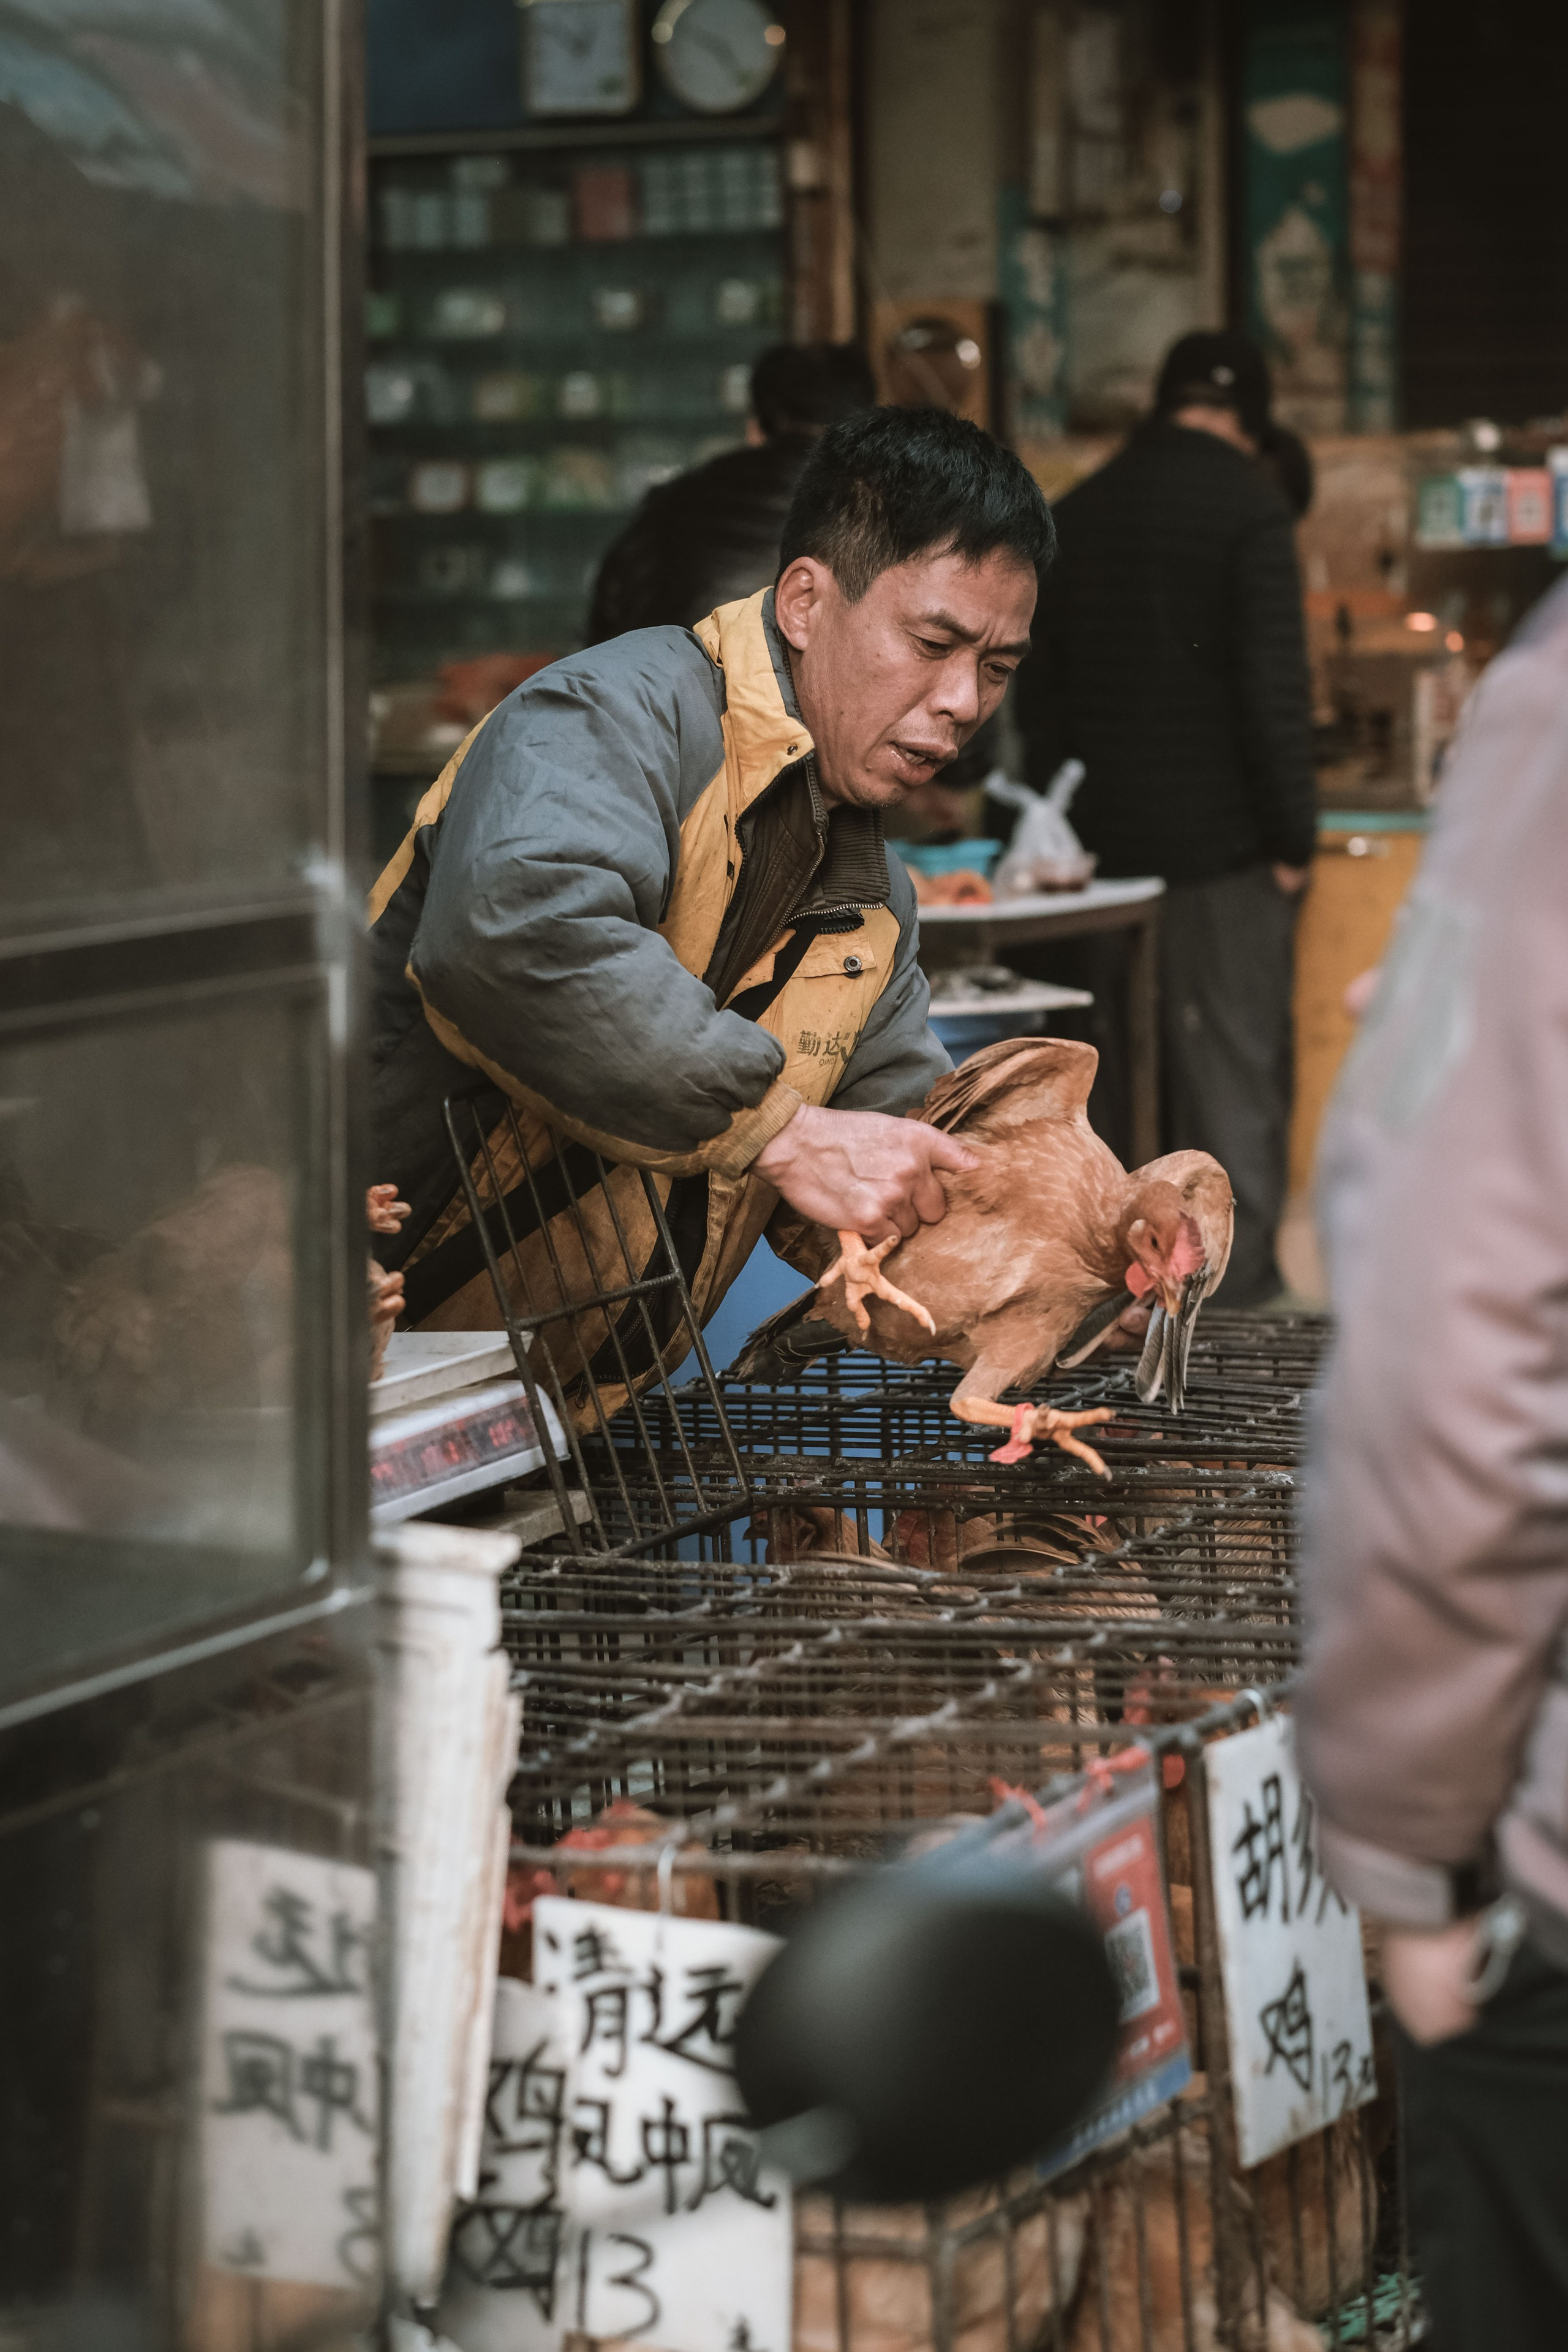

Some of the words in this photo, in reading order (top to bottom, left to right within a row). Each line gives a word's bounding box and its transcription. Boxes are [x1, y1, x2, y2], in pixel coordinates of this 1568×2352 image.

[819, 1058, 837, 1067] QIND
[544, 1922, 741, 2079] 清远
[1259, 1954, 1313, 2091] 鸡
[576, 2228, 662, 2342] 13
